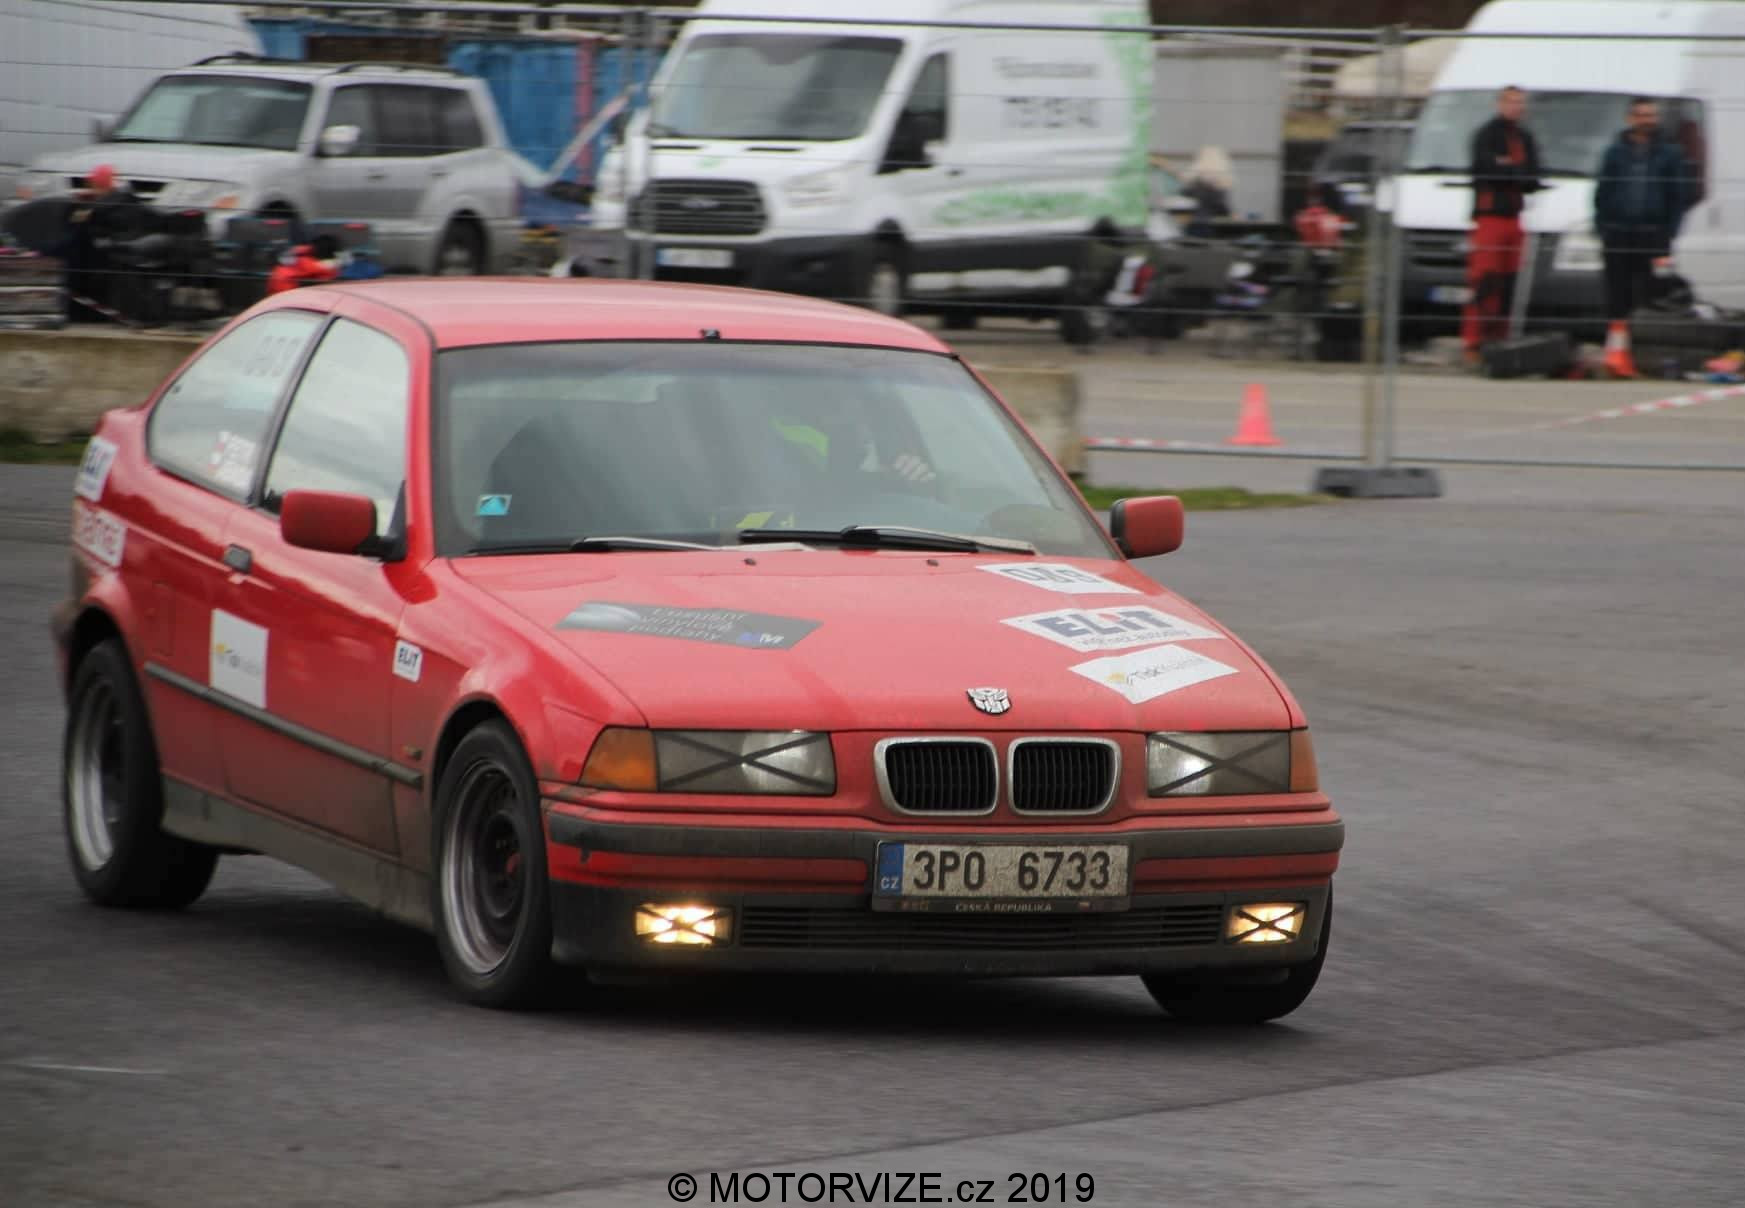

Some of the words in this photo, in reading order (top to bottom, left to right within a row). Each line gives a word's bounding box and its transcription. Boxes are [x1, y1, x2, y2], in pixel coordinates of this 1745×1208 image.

[1017, 850, 1111, 892] 6733
[880, 877, 899, 890] CZ
[993, 901, 1052, 913] REPUBLIKA
